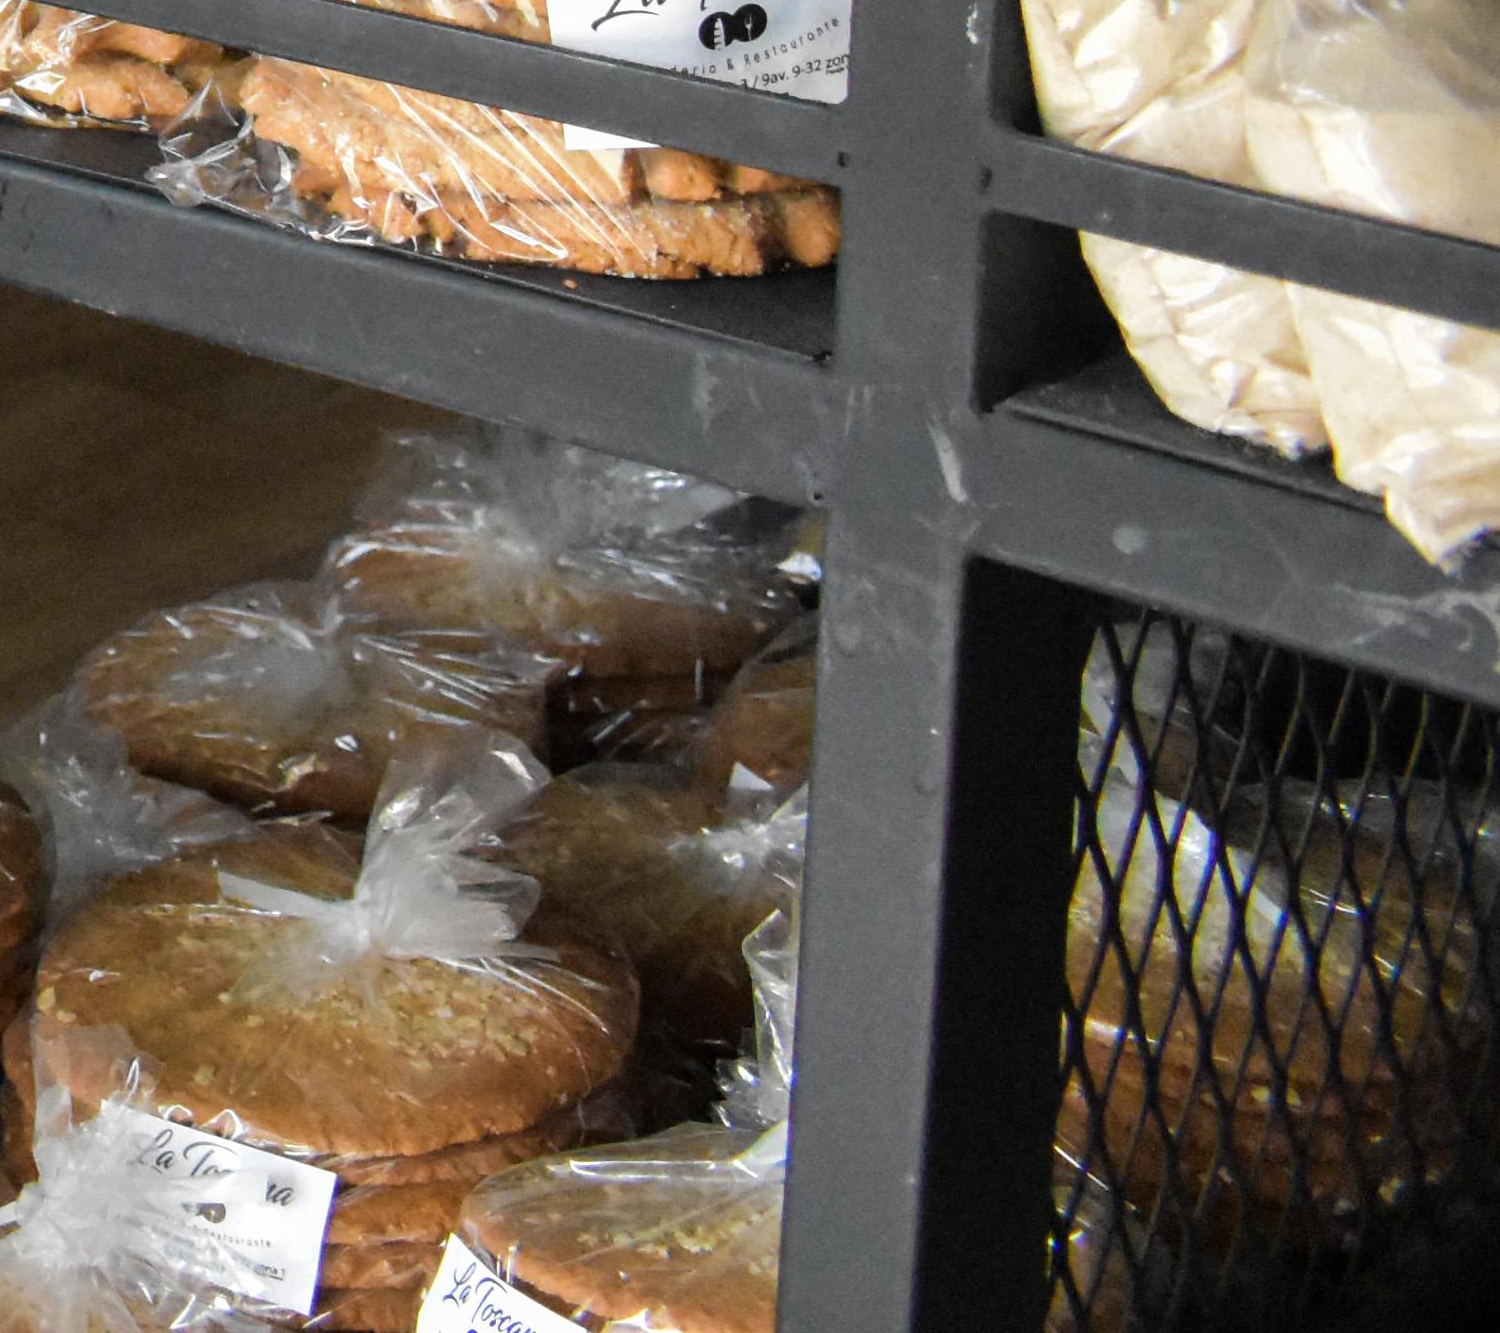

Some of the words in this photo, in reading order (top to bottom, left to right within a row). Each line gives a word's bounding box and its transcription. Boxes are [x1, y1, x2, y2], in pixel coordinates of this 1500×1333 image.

[726, 57, 735, 71] &
[743, 17, 840, 66] Restaurante
[791, 58, 822, 78] 9-32
[825, 54, 851, 69] zon
[442, 1262, 473, 1309] La
